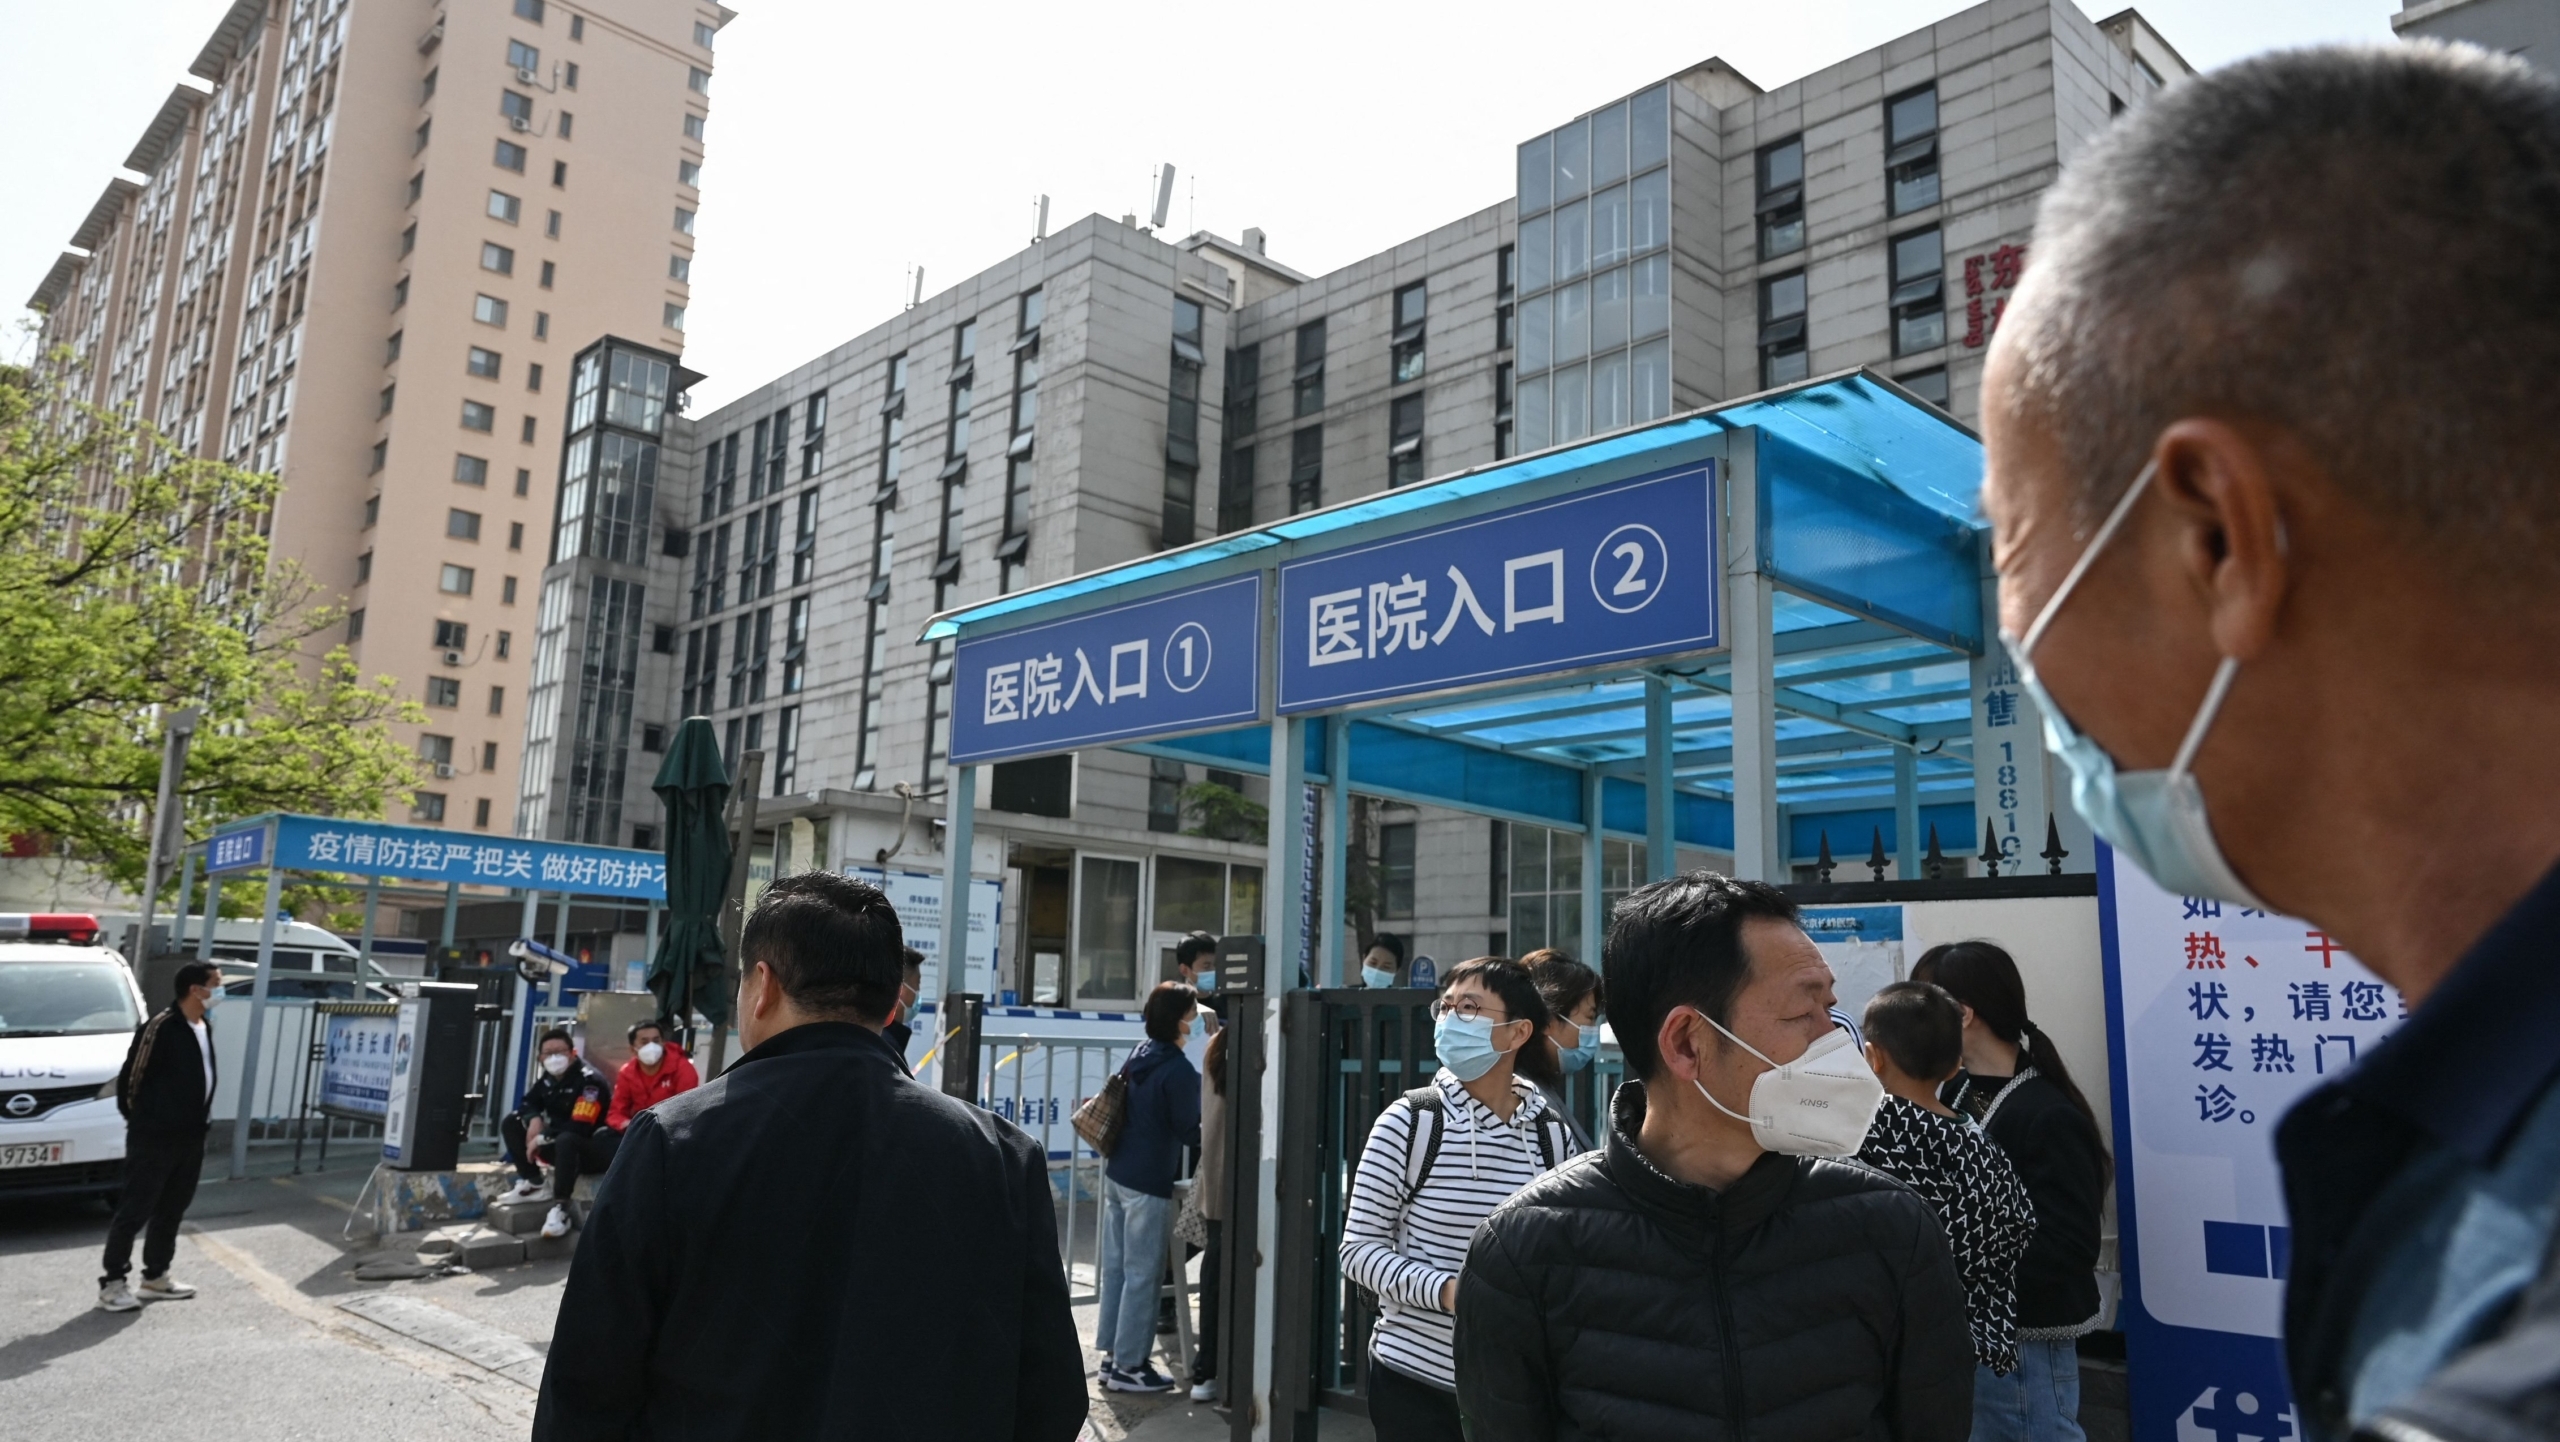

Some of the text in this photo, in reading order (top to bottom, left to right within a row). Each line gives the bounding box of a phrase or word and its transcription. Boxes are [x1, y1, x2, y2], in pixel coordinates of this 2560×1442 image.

[1964, 254, 1986, 298] East
[1989, 244, 2028, 333] 东
[1308, 548, 1565, 668] 医院入口
[984, 638, 1149, 726] 医院入口
[215, 836, 253, 866] 医院出口
[308, 830, 533, 880] 疫情防控严把关
[2181, 893, 2284, 920] 如
[2192, 1032, 2388, 1074] 发热门
[1800, 1098, 1829, 1109] KN95
